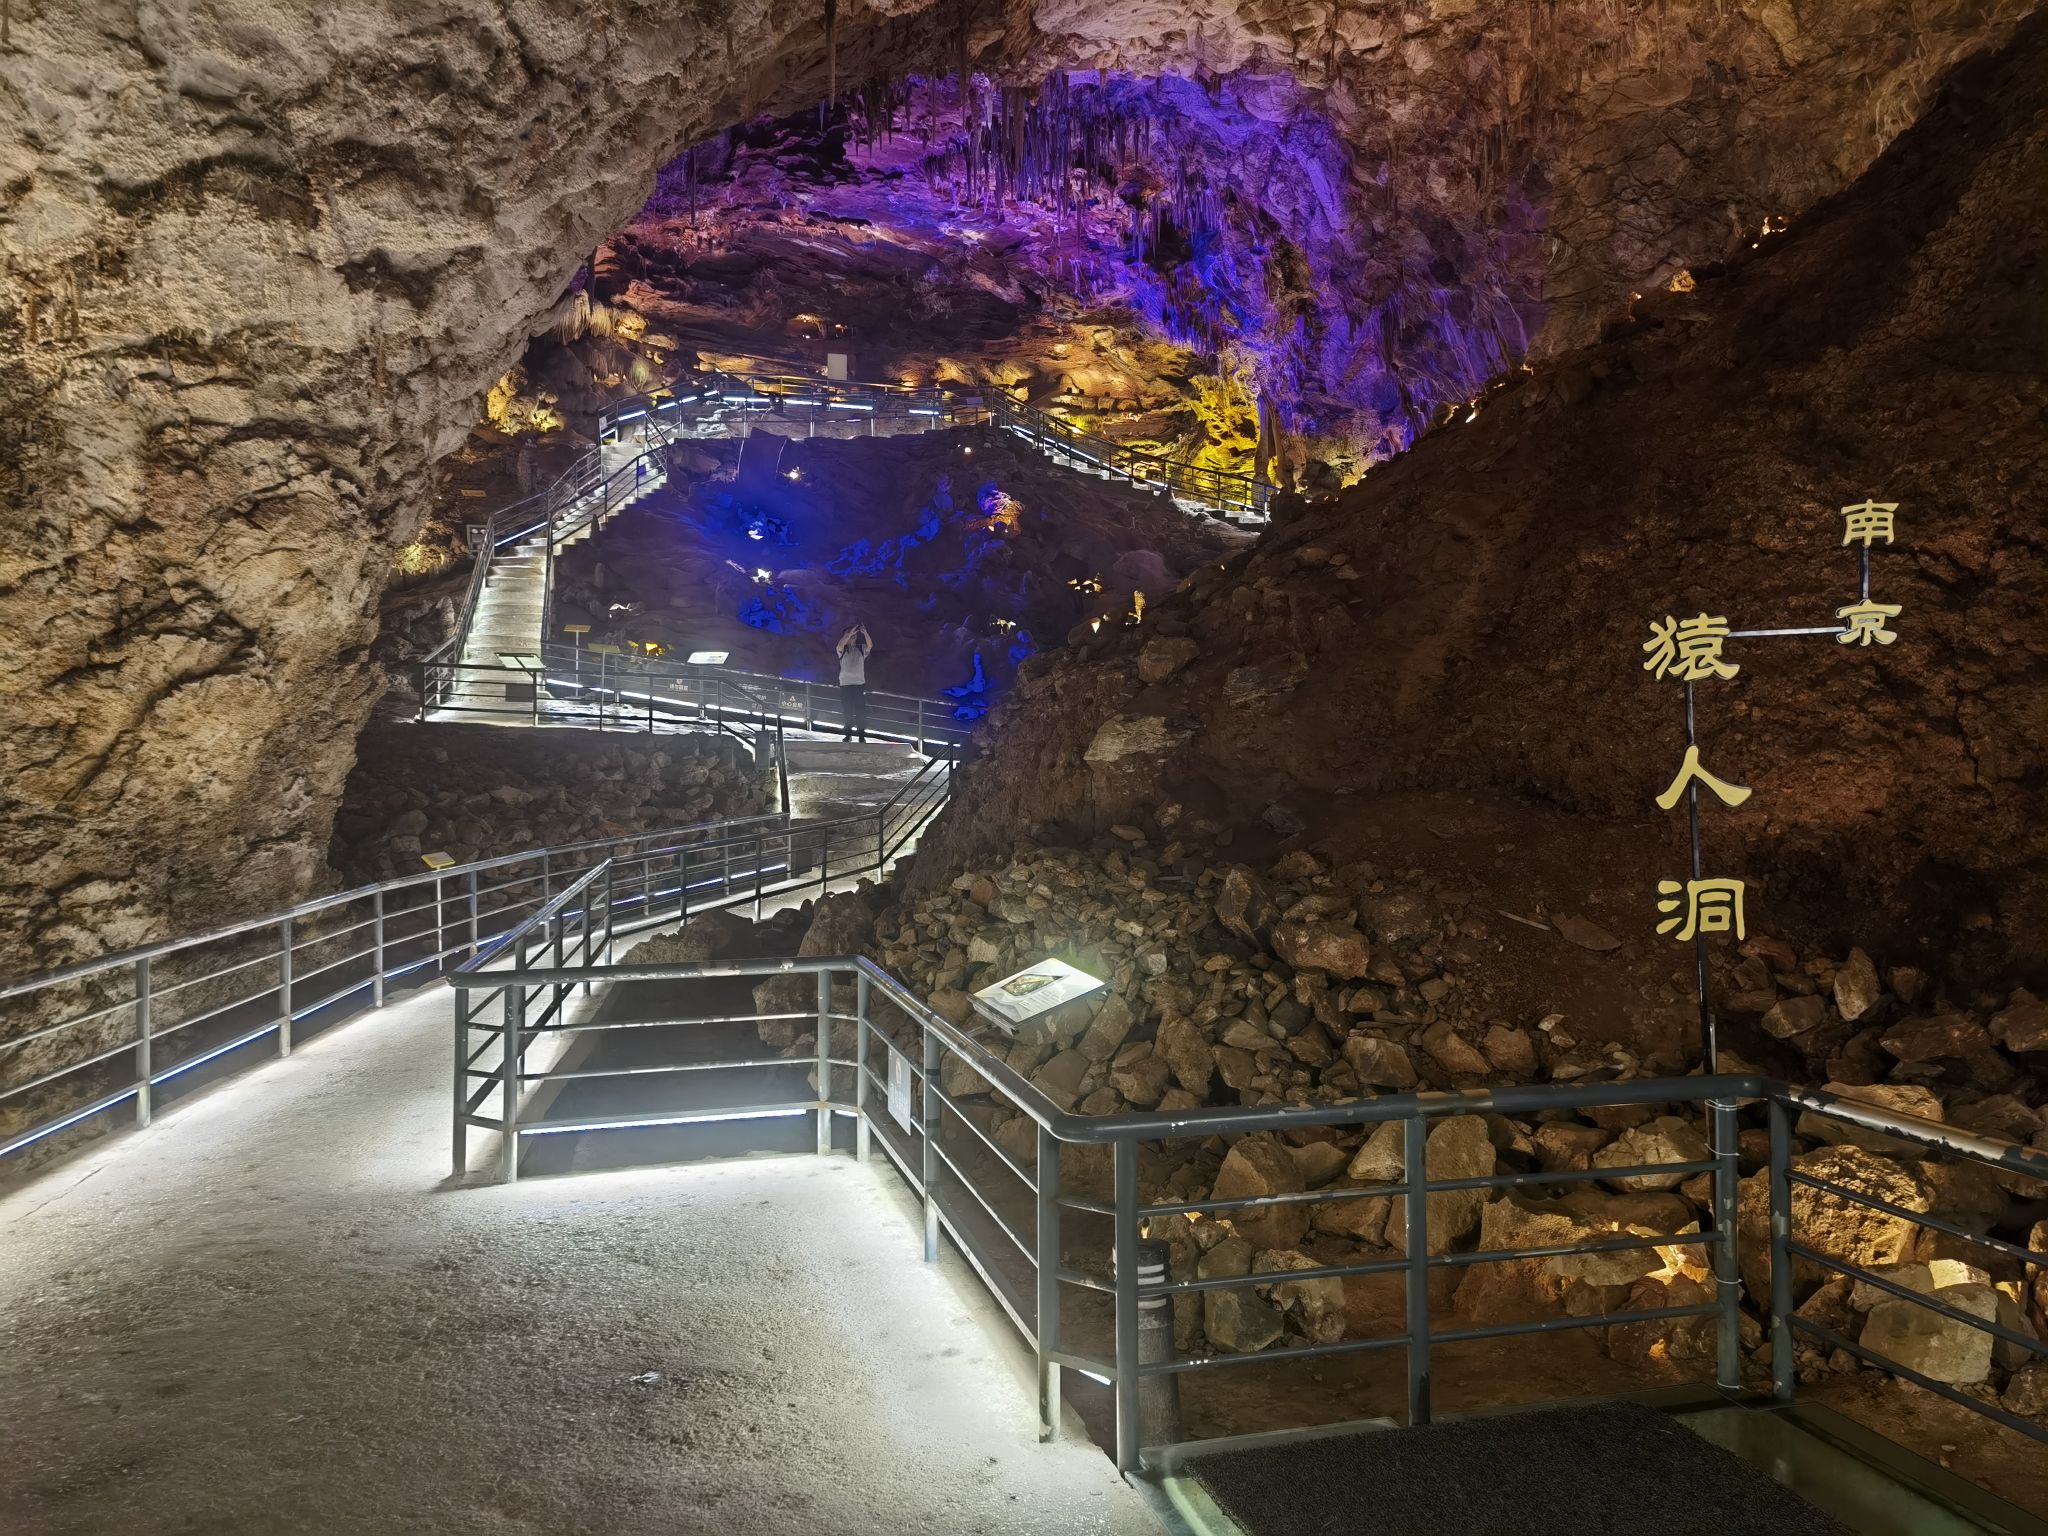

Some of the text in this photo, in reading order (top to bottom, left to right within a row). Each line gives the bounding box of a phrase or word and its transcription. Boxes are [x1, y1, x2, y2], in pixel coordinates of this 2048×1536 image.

[1836, 498, 1903, 647] 南京
[1643, 612, 1752, 942] 猿人洞
